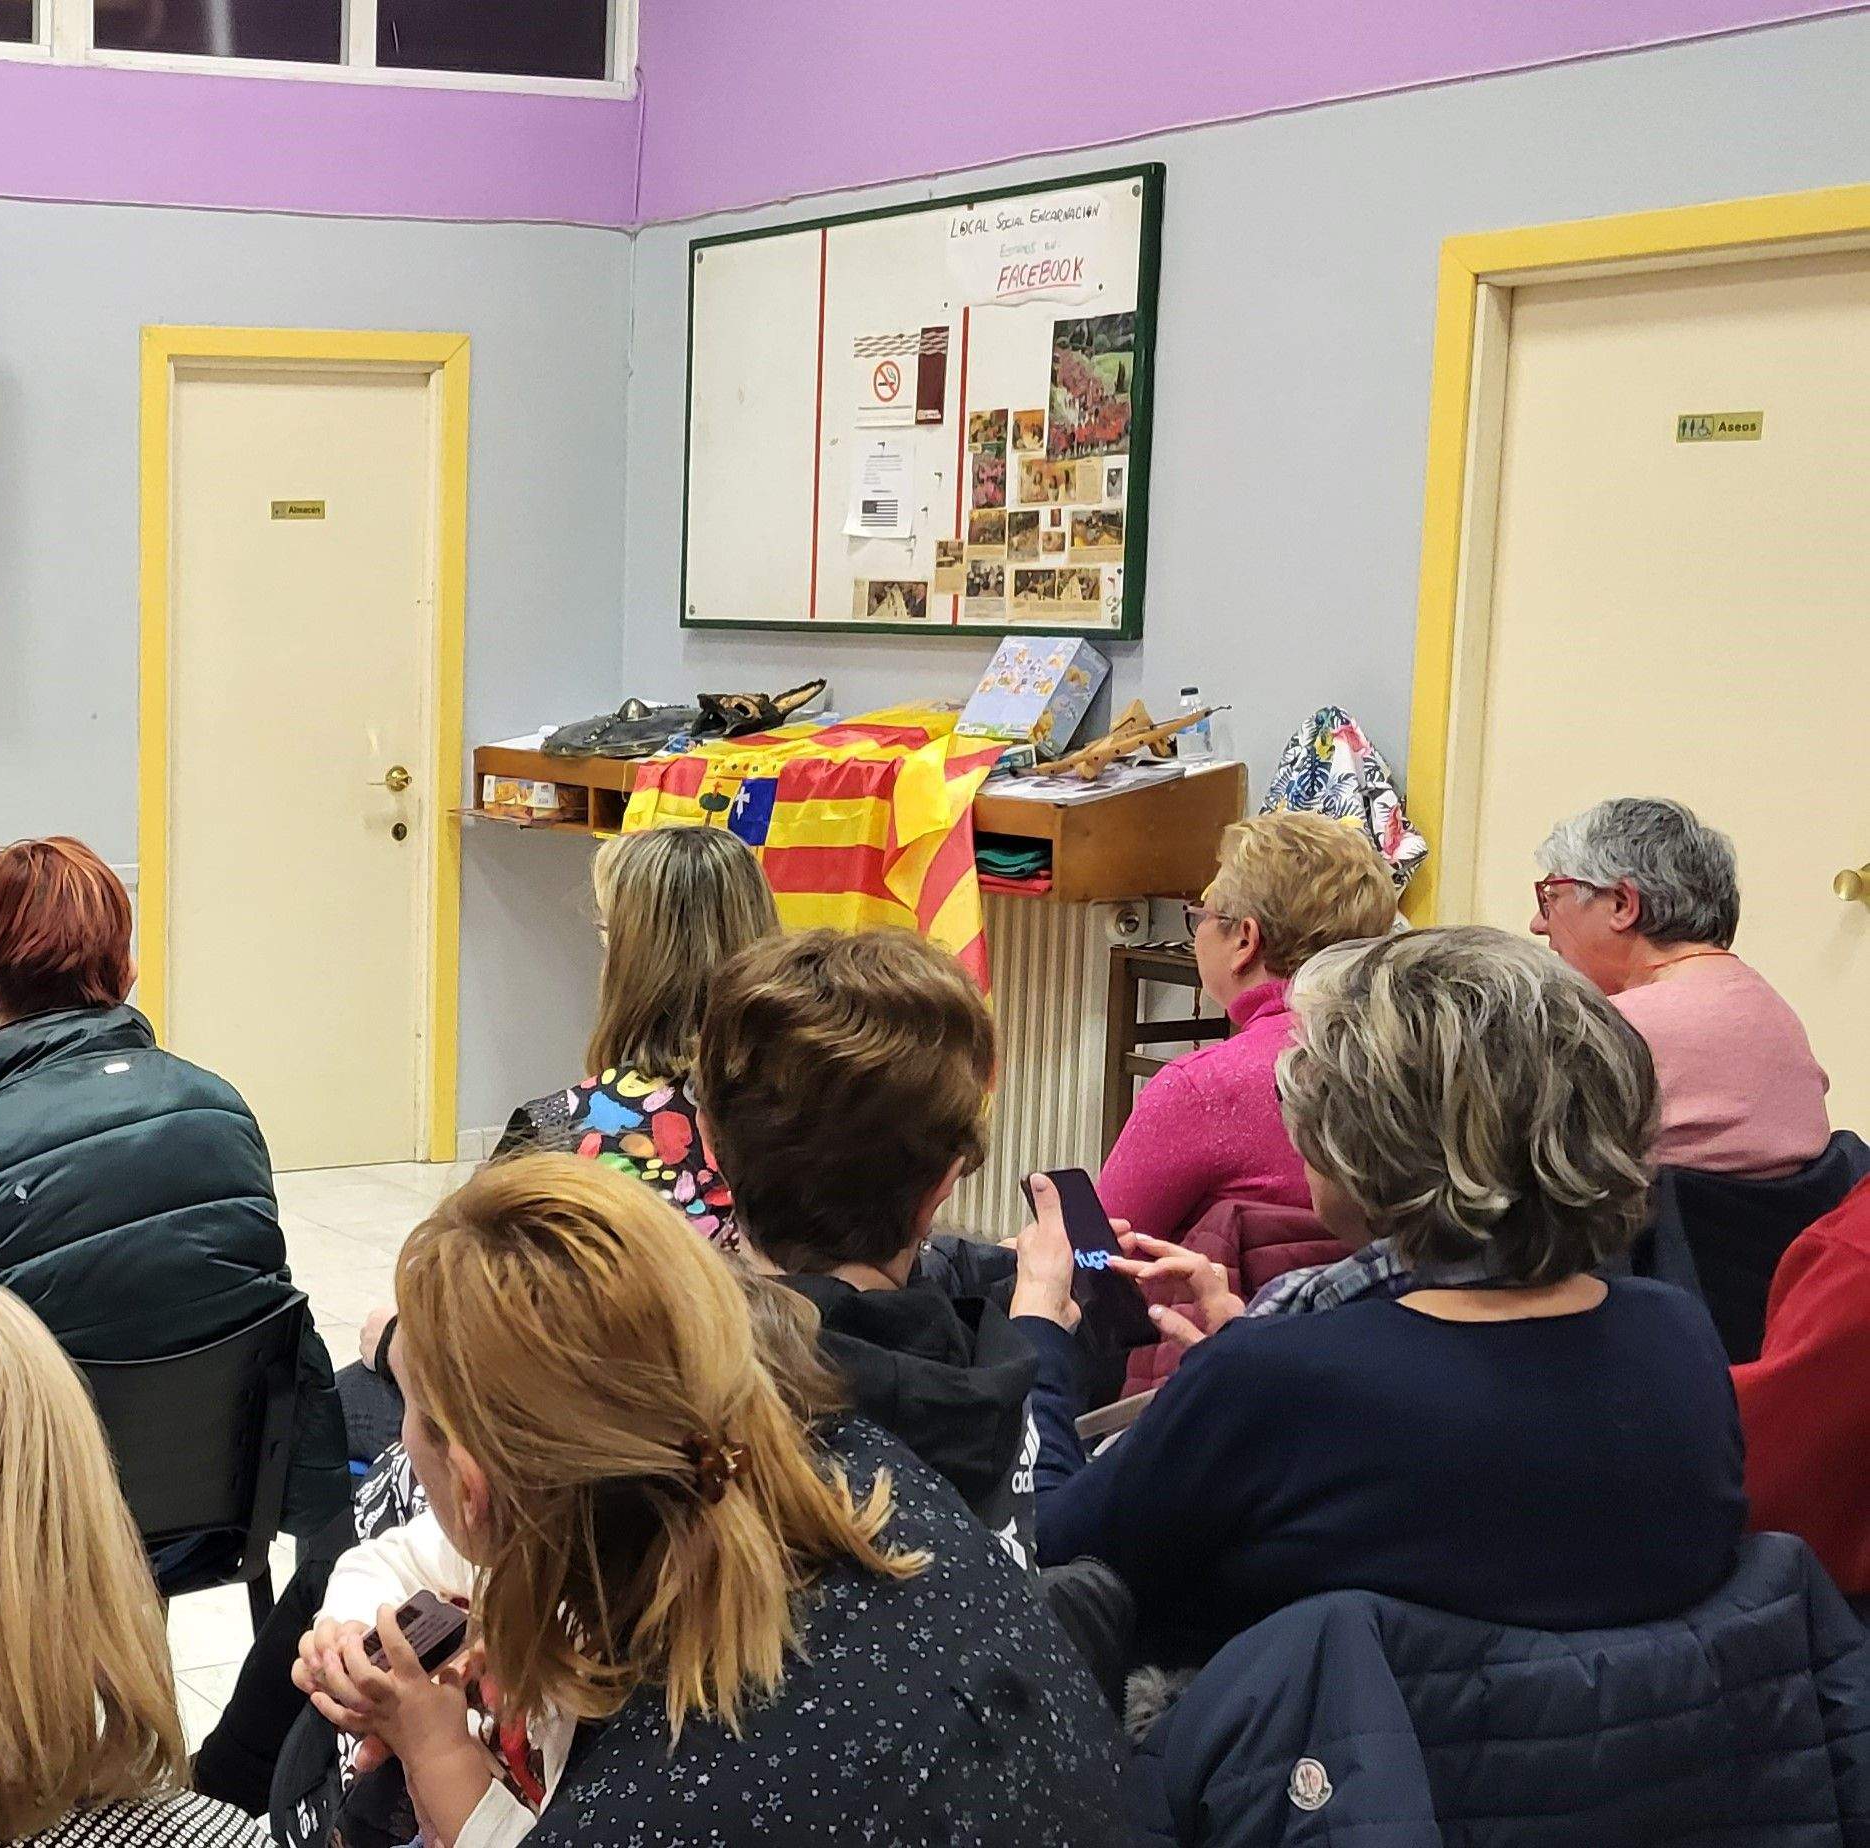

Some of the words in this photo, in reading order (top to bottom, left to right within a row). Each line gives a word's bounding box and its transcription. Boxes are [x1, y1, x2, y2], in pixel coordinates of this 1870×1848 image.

[950, 217, 989, 238] LOCAL
[997, 256, 1084, 291] FACEBOOK
[1718, 421, 1757, 432] Aseos
